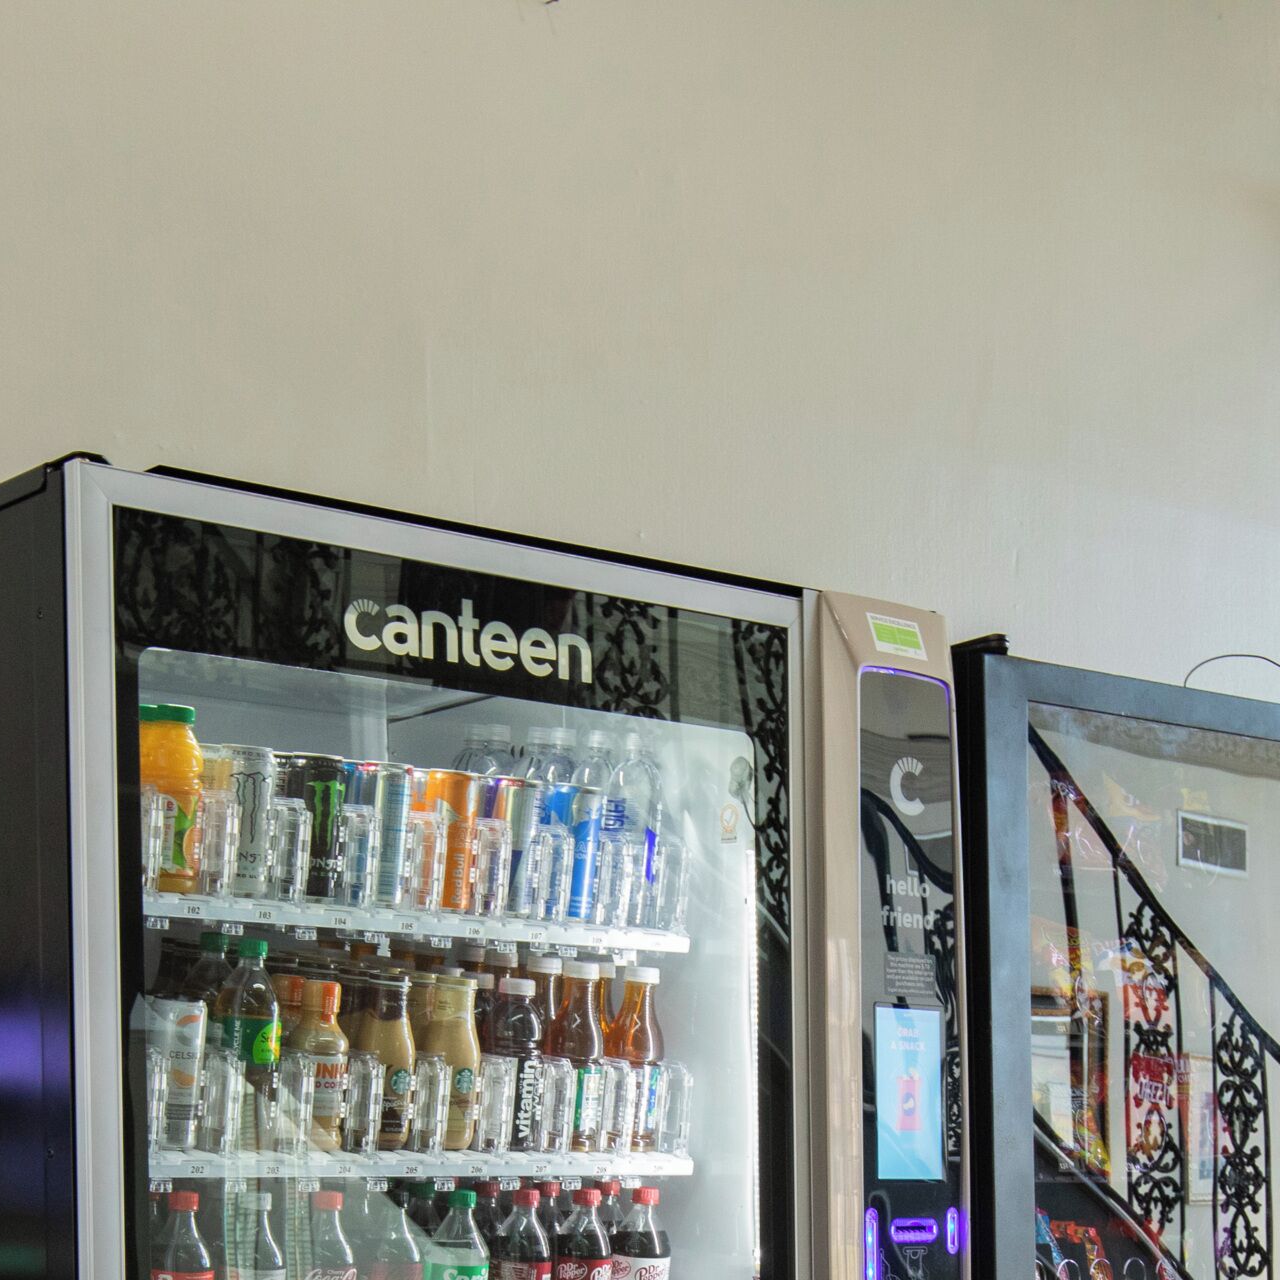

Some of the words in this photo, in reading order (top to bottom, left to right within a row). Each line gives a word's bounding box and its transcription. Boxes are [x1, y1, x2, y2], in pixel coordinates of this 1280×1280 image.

[344, 598, 593, 684] canteen
[454, 850, 466, 876] Bull
[886, 873, 930, 898] hello
[186, 906, 201, 915] 102
[258, 910, 272, 919] 103
[334, 917, 347, 926] 104
[881, 904, 935, 930] friend
[401, 922, 414, 931] 105
[468, 927, 481, 936] 106
[530, 932, 542, 940] 107
[519, 1059, 538, 1138] vitamin
[190, 1164, 205, 1175] 202
[266, 1165, 280, 1175] 203
[338, 1165, 352, 1175] 204
[405, 1165, 419, 1175] 205
[471, 1165, 483, 1174] 206
[535, 1165, 548, 1174] 207
[595, 1165, 608, 1174] 208
[565, 1262, 579, 1270] Dr
[648, 1264, 660, 1274] Dr
[560, 1264, 585, 1280] Pepper
